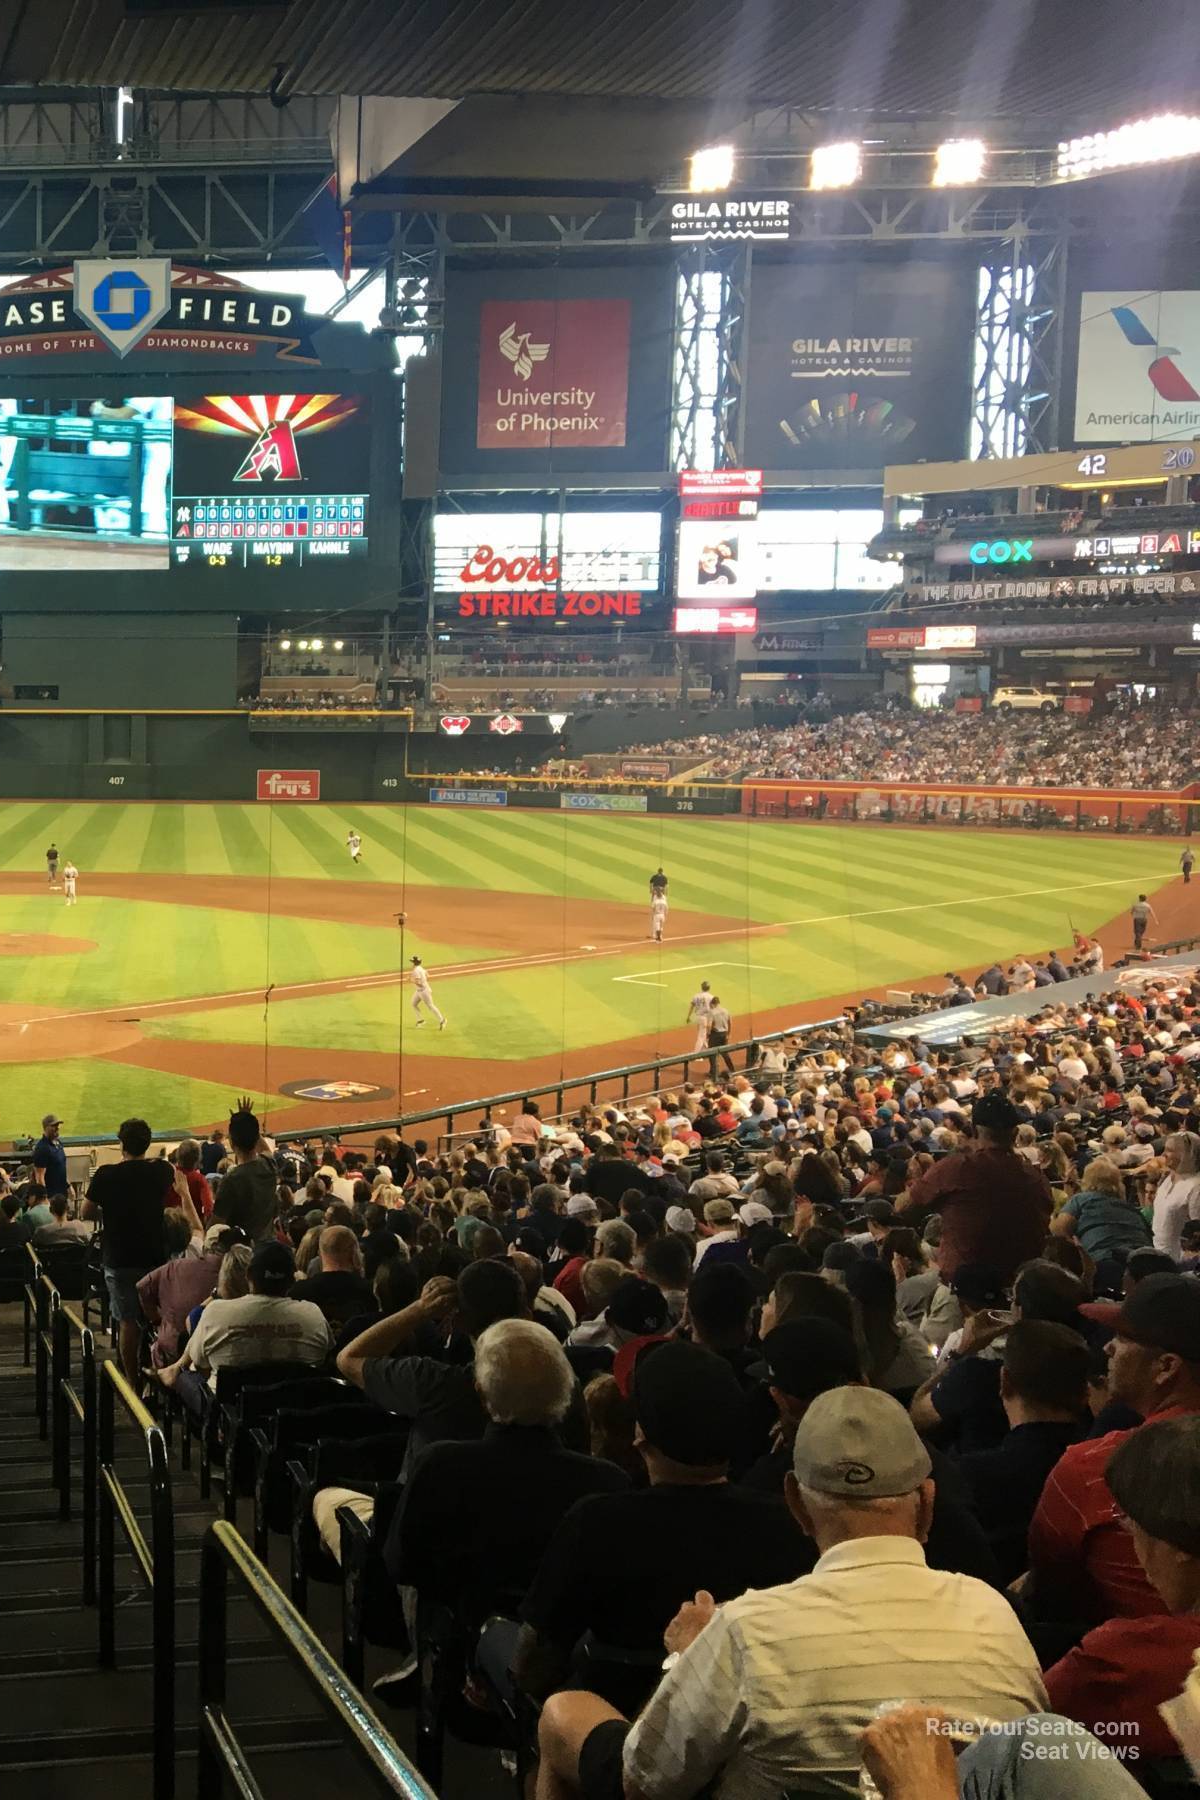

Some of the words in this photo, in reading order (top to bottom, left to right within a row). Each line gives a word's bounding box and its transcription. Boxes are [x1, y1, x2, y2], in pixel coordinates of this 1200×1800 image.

[672, 203, 721, 218] GILA
[725, 201, 789, 216] RIVER
[736, 219, 789, 227] CASINOS
[179, 298, 292, 326] FIELD
[43, 341, 60, 350] OF
[70, 339, 95, 349] THE
[147, 338, 250, 351] DIAMONDBACKS
[792, 338, 842, 354] GILA
[846, 337, 913, 353] RIVER
[497, 388, 596, 408] University
[497, 413, 516, 431] of
[520, 413, 600, 431] Phoenix
[1086, 411, 1160, 426] American
[1077, 455, 1106, 476] 42
[1160, 448, 1195, 471] 20
[203, 543, 233, 555] WADE
[253, 542, 294, 555] MAYBIN
[969, 540, 1033, 564] COX
[209, 556, 226, 566] 0-3
[265, 556, 281, 565] 1-2
[459, 544, 560, 584] Coors
[954, 583, 1002, 600] DRAFT
[1006, 581, 1051, 598] ROOM
[1077, 579, 1128, 595] CRAFT
[1133, 577, 1176, 593] BEER
[1181, 577, 1196, 592] &
[459, 592, 556, 616] STRIKE
[562, 592, 641, 616] ZONE
[109, 776, 124, 785] 407
[265, 773, 311, 796] fry's
[382, 779, 397, 787] 413
[570, 795, 597, 806] COX
